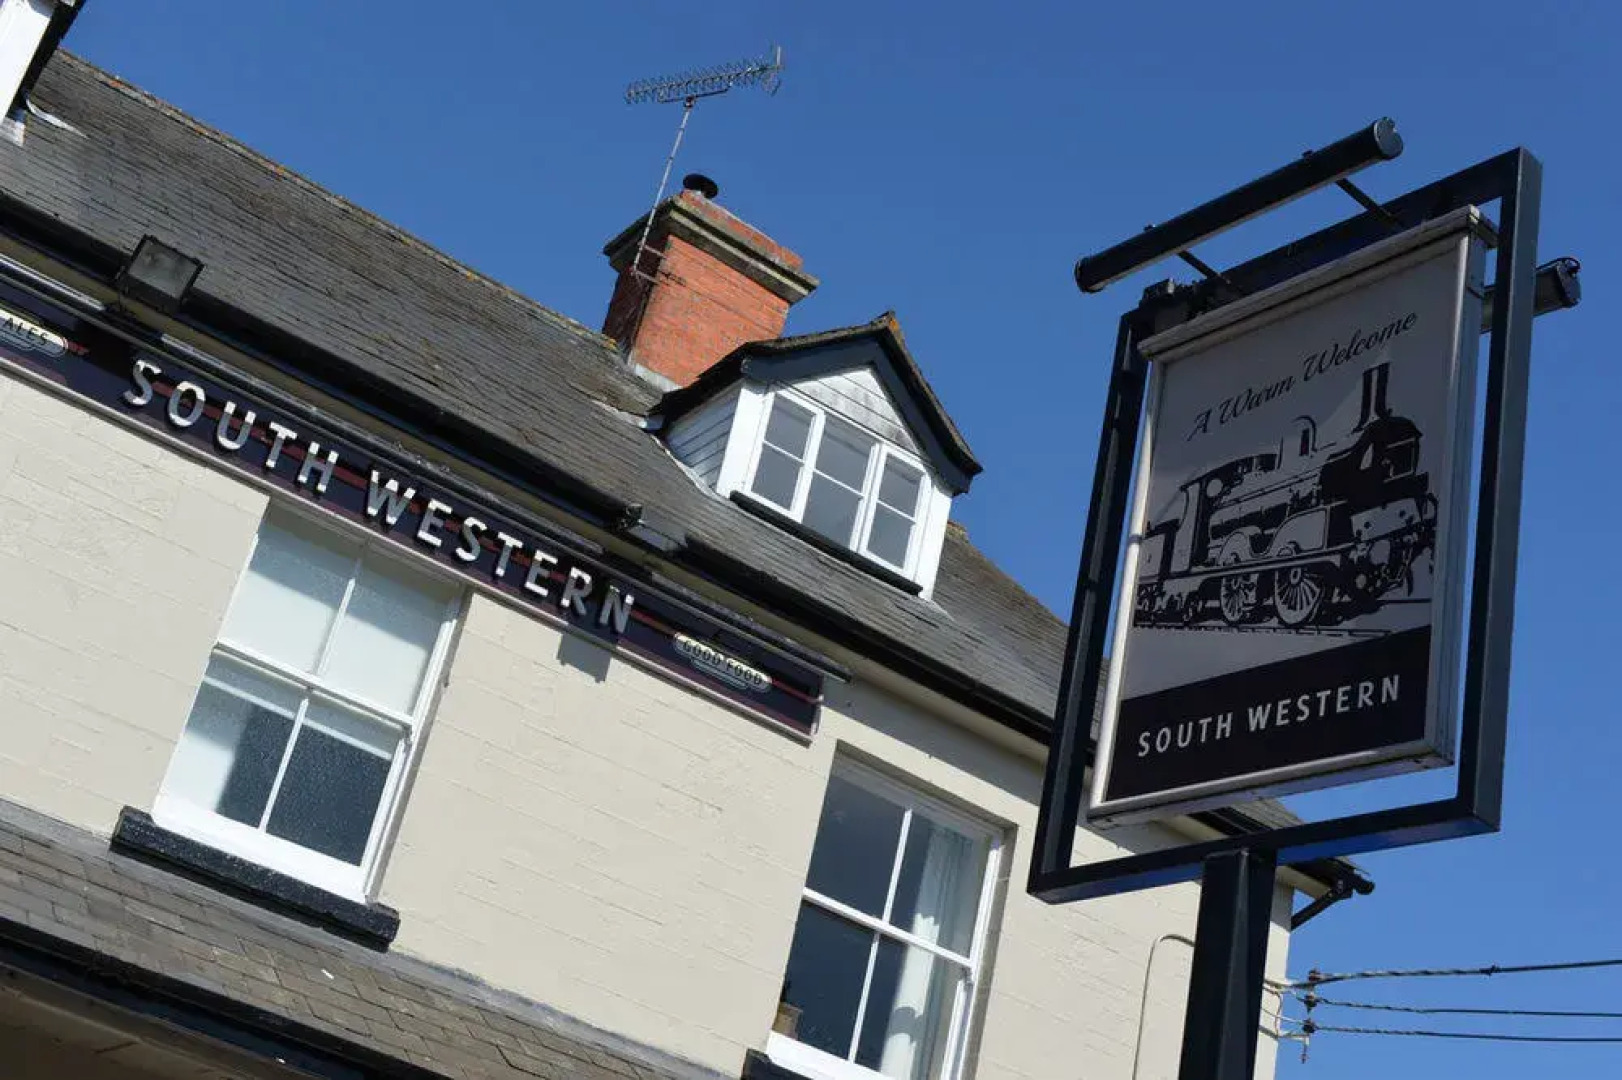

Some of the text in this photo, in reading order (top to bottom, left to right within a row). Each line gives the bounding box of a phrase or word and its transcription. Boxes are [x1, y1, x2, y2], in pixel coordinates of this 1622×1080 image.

[2, 317, 49, 346] ALES
[1187, 312, 1417, 442] A Warm Welcome
[123, 358, 636, 634] SOUTH WESTERN
[683, 639, 764, 685] GOOD FOOD
[1137, 674, 1401, 757] SOUTH WESTERN
